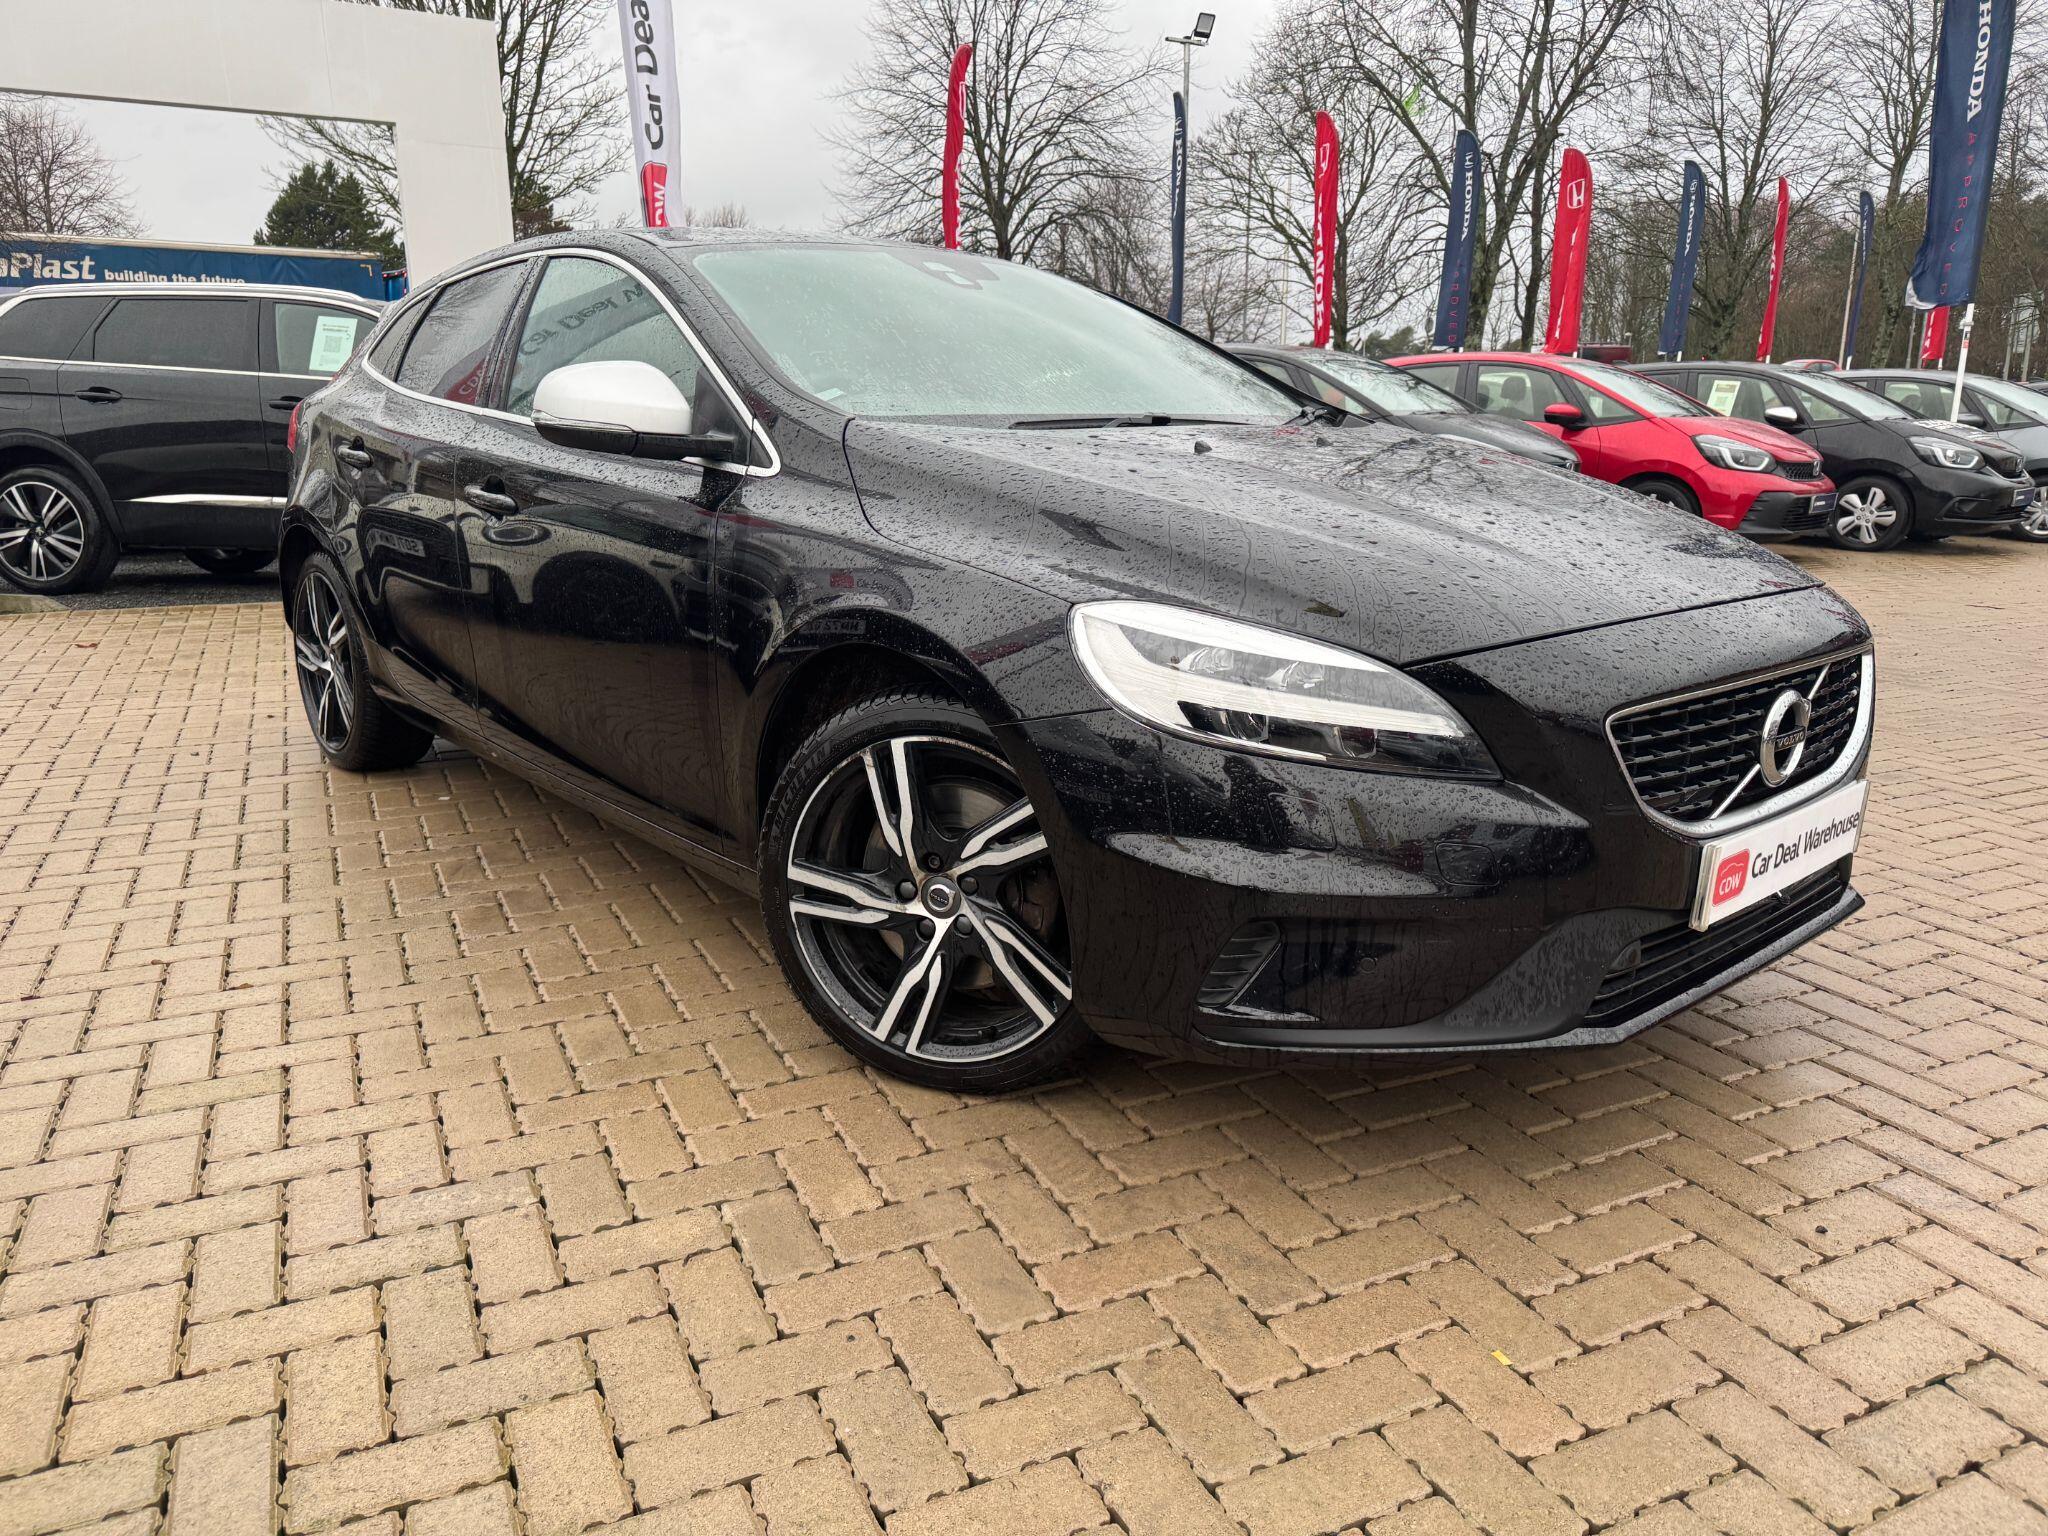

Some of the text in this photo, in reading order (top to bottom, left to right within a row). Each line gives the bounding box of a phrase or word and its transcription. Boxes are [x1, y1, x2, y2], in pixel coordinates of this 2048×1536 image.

[1967, 0, 1992, 123] HONDA
[644, 84, 664, 151] Car
[1461, 172, 1474, 242] HONDA
[104, 269, 167, 283] building
[171, 273, 197, 284] the
[1776, 730, 1805, 748] VOLVO
[1752, 811, 1860, 878] Car Deal Warehouse
[1719, 871, 1743, 897] CDW
